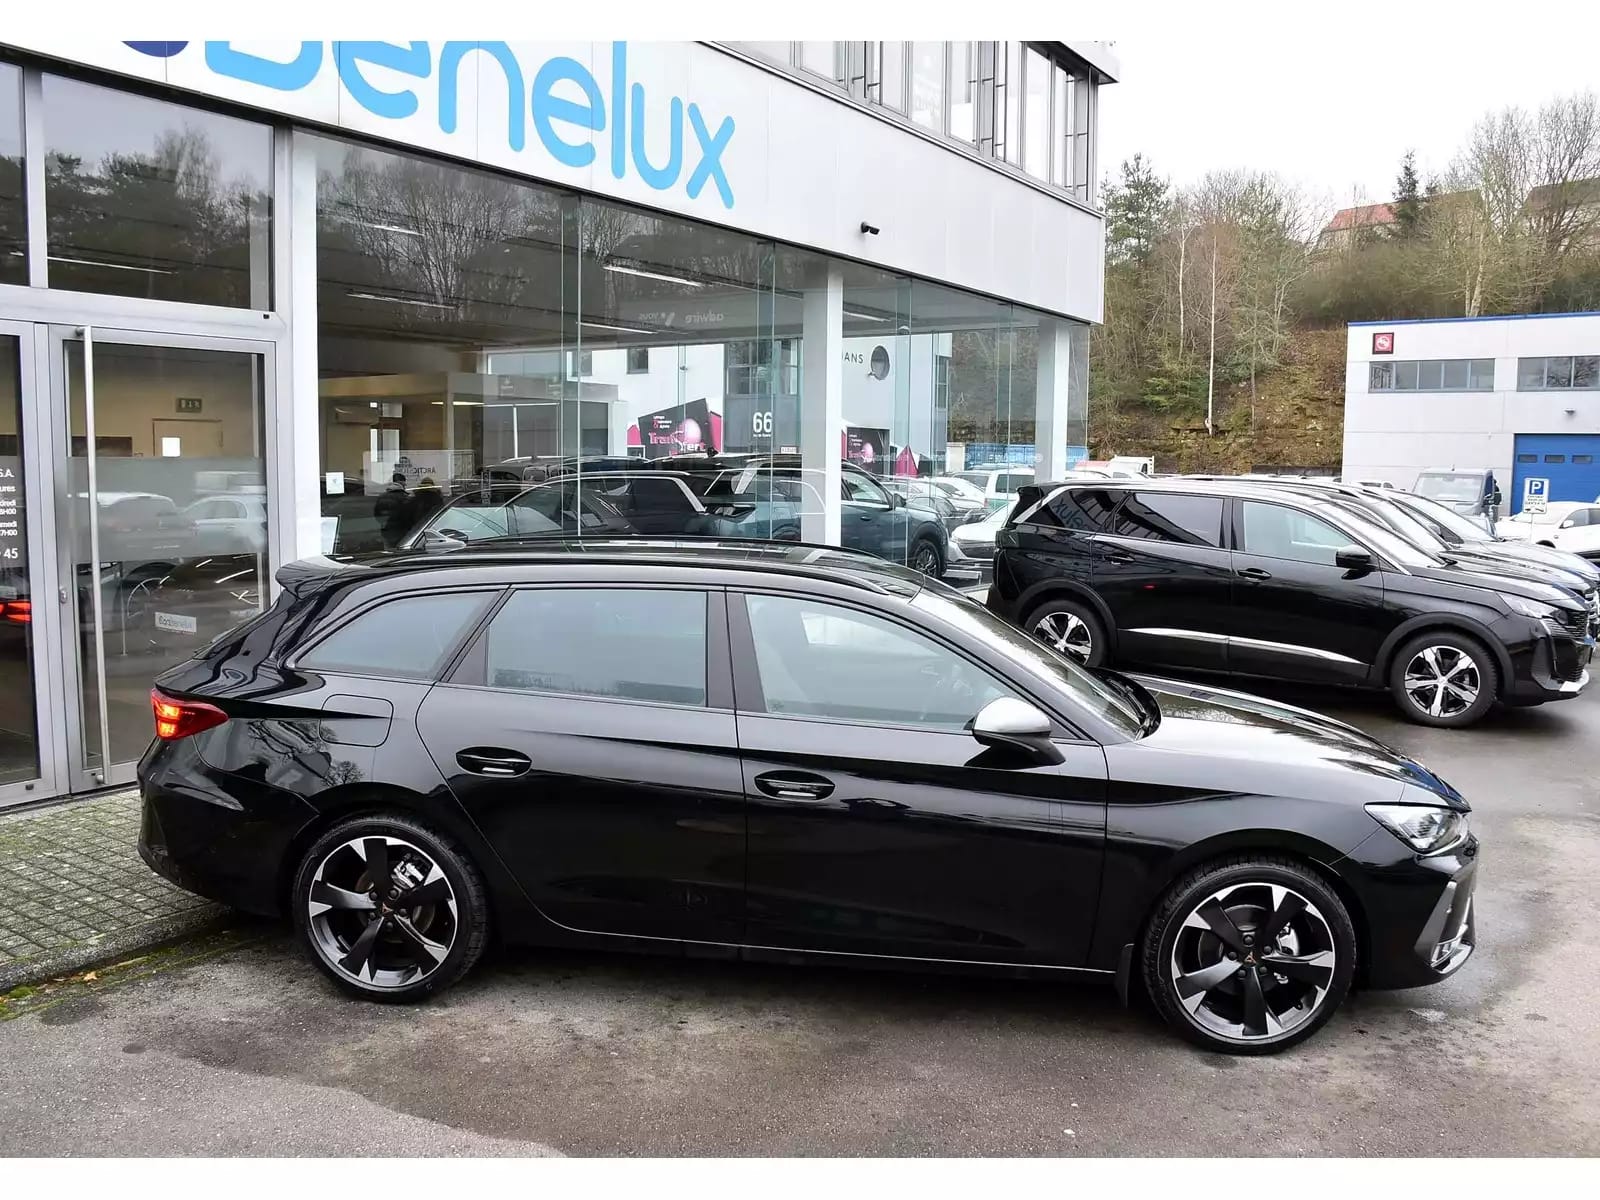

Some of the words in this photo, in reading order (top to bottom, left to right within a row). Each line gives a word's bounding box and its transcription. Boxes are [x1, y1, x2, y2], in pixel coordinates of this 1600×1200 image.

[205, 41, 735, 210] enelux
[753, 411, 772, 433] 66
[1531, 481, 1542, 495] P
